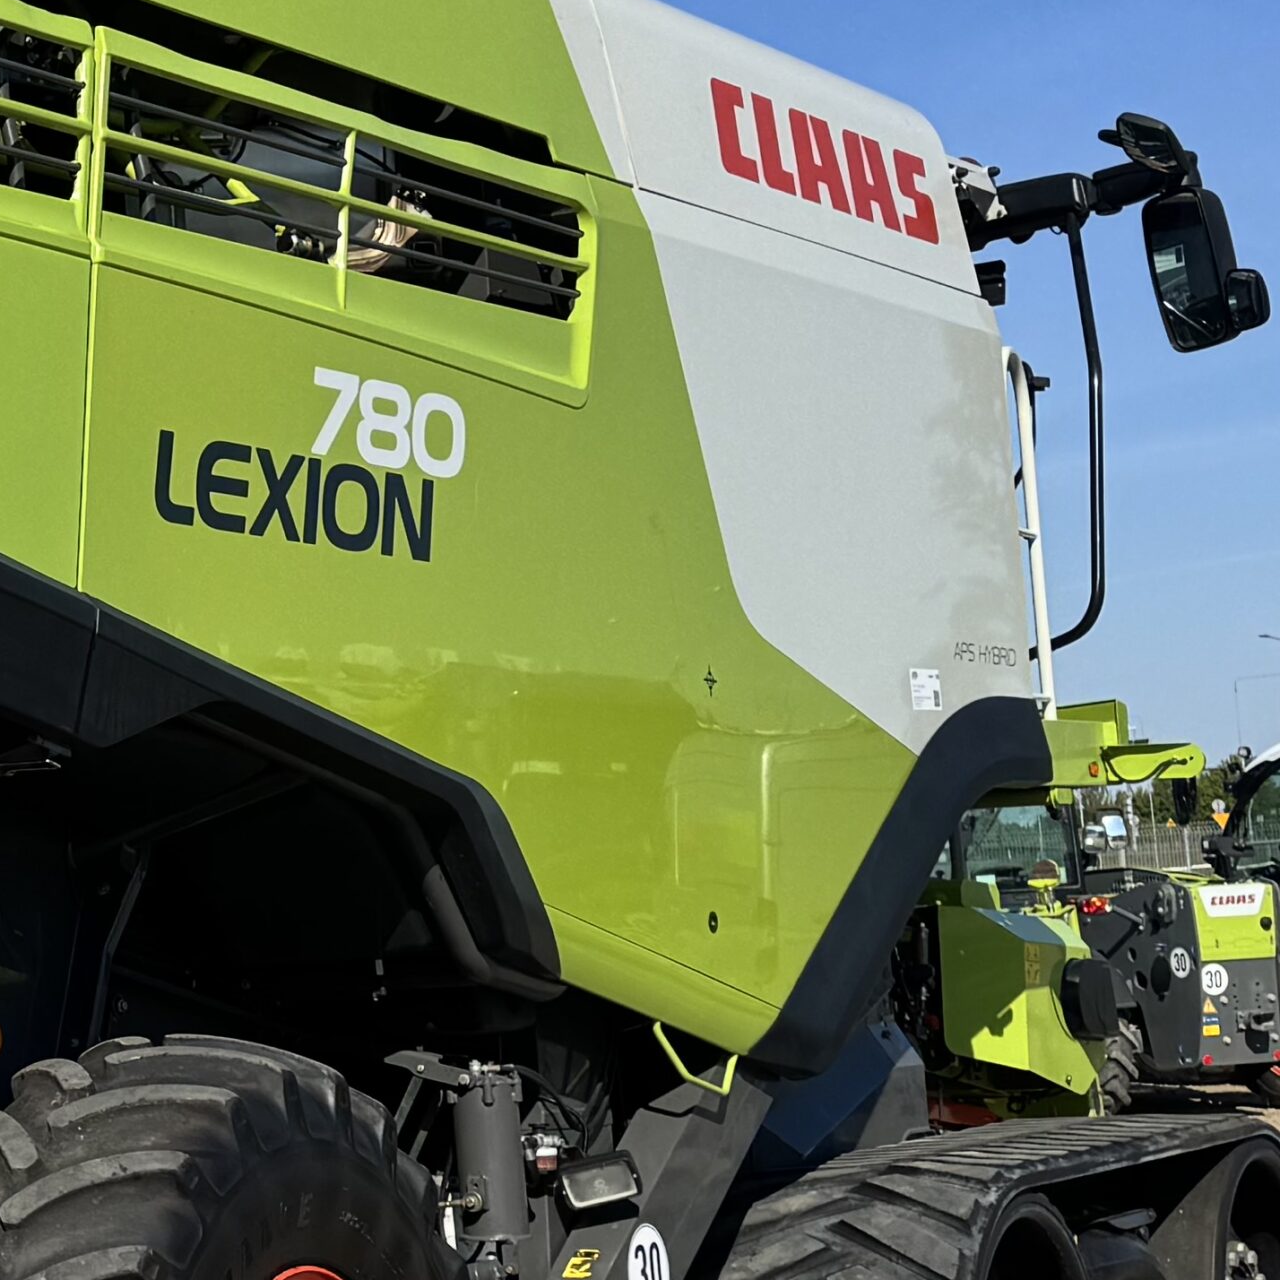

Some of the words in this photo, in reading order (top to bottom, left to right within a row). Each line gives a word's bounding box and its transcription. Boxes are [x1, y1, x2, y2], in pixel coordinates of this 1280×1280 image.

[711, 77, 940, 245] CLAAS
[311, 366, 466, 478] 780
[154, 429, 434, 562] LEXION
[953, 641, 976, 663] APS
[1210, 893, 1256, 907] CLAAS
[1173, 952, 1187, 972] 30
[1204, 969, 1223, 989] 30
